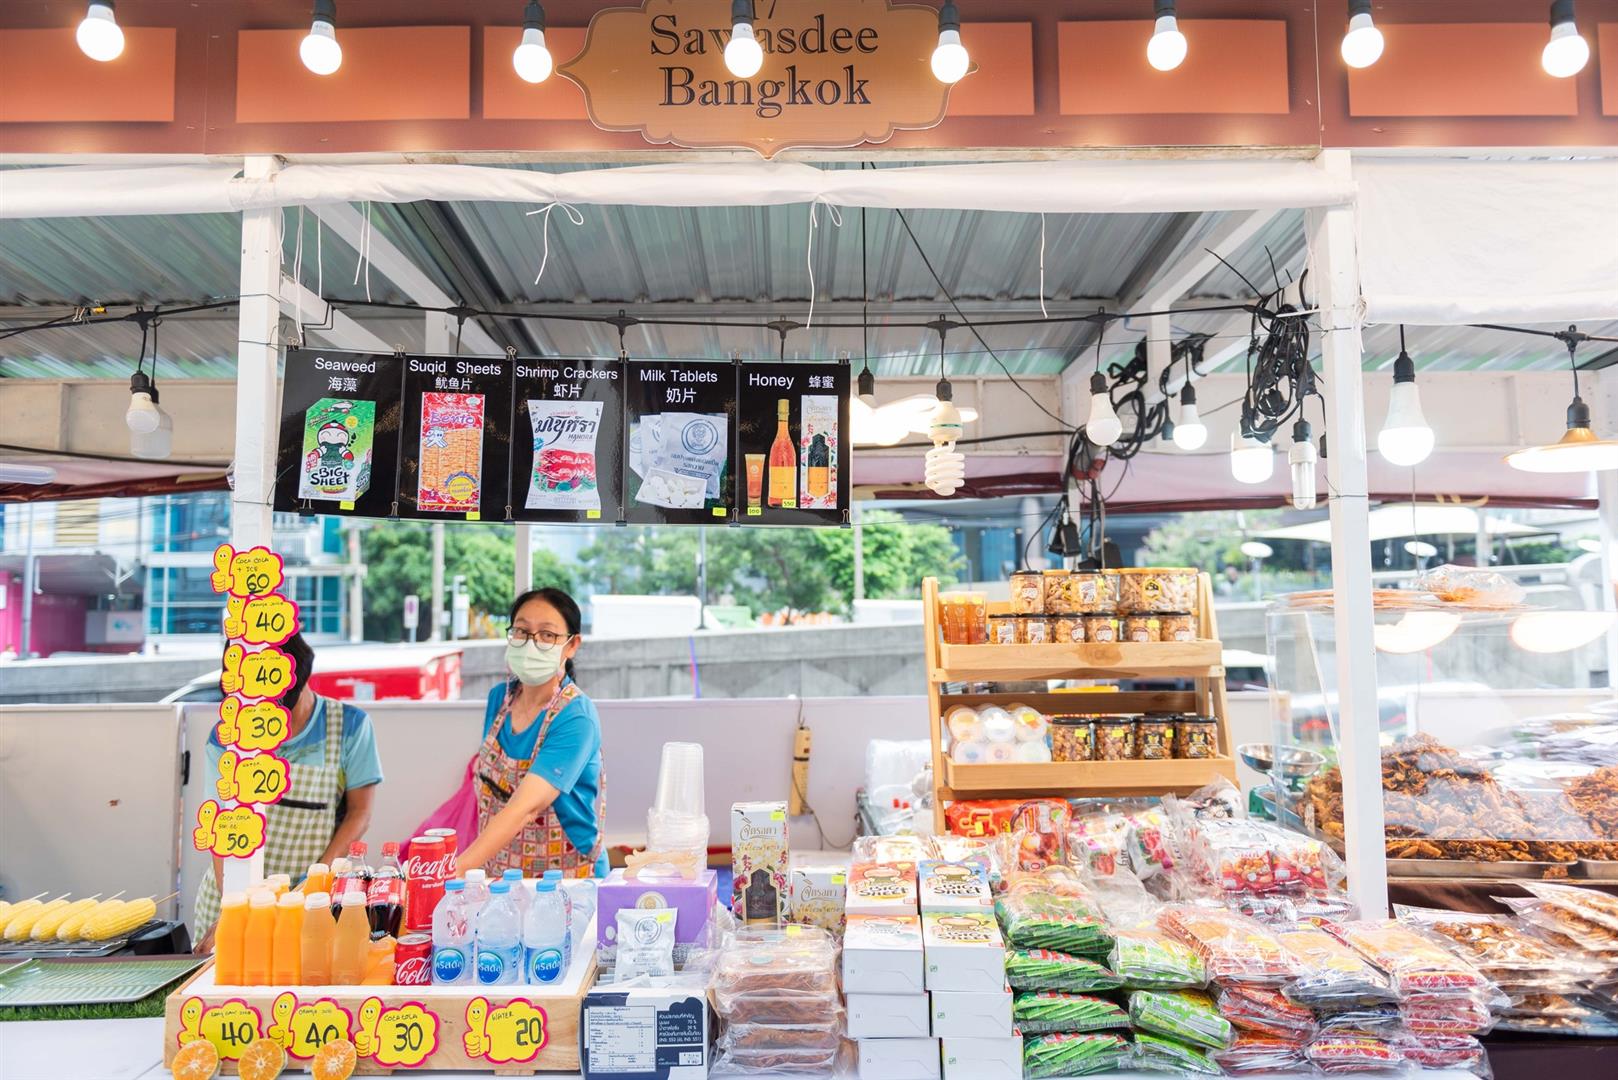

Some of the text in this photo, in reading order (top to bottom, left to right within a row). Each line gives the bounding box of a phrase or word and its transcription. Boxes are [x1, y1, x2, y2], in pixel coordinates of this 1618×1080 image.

[658, 65, 872, 118] Bangkok
[314, 358, 376, 373] Seaweed
[409, 360, 501, 376] Suqid Sheets
[516, 366, 618, 382] Shrimp Crackers
[640, 370, 718, 383] Milk Tablets
[749, 374, 794, 388] Honey
[328, 377, 358, 392] 海藻
[435, 377, 473, 391] 鱿鱼片
[809, 376, 834, 389] 蜂蜜
[553, 383, 582, 399] 虾片
[666, 388, 697, 403] 奶片
[430, 412, 475, 424] Bento
[311, 471, 350, 486] SHEET
[320, 467, 342, 478] BIG
[247, 573, 269, 592] 60
[256, 611, 285, 632] 40
[256, 665, 282, 686] 40
[252, 717, 282, 739] 30
[253, 769, 280, 794] 20
[222, 1022, 254, 1046] 40
[394, 1022, 423, 1052] 30
[516, 1017, 542, 1046] 20
